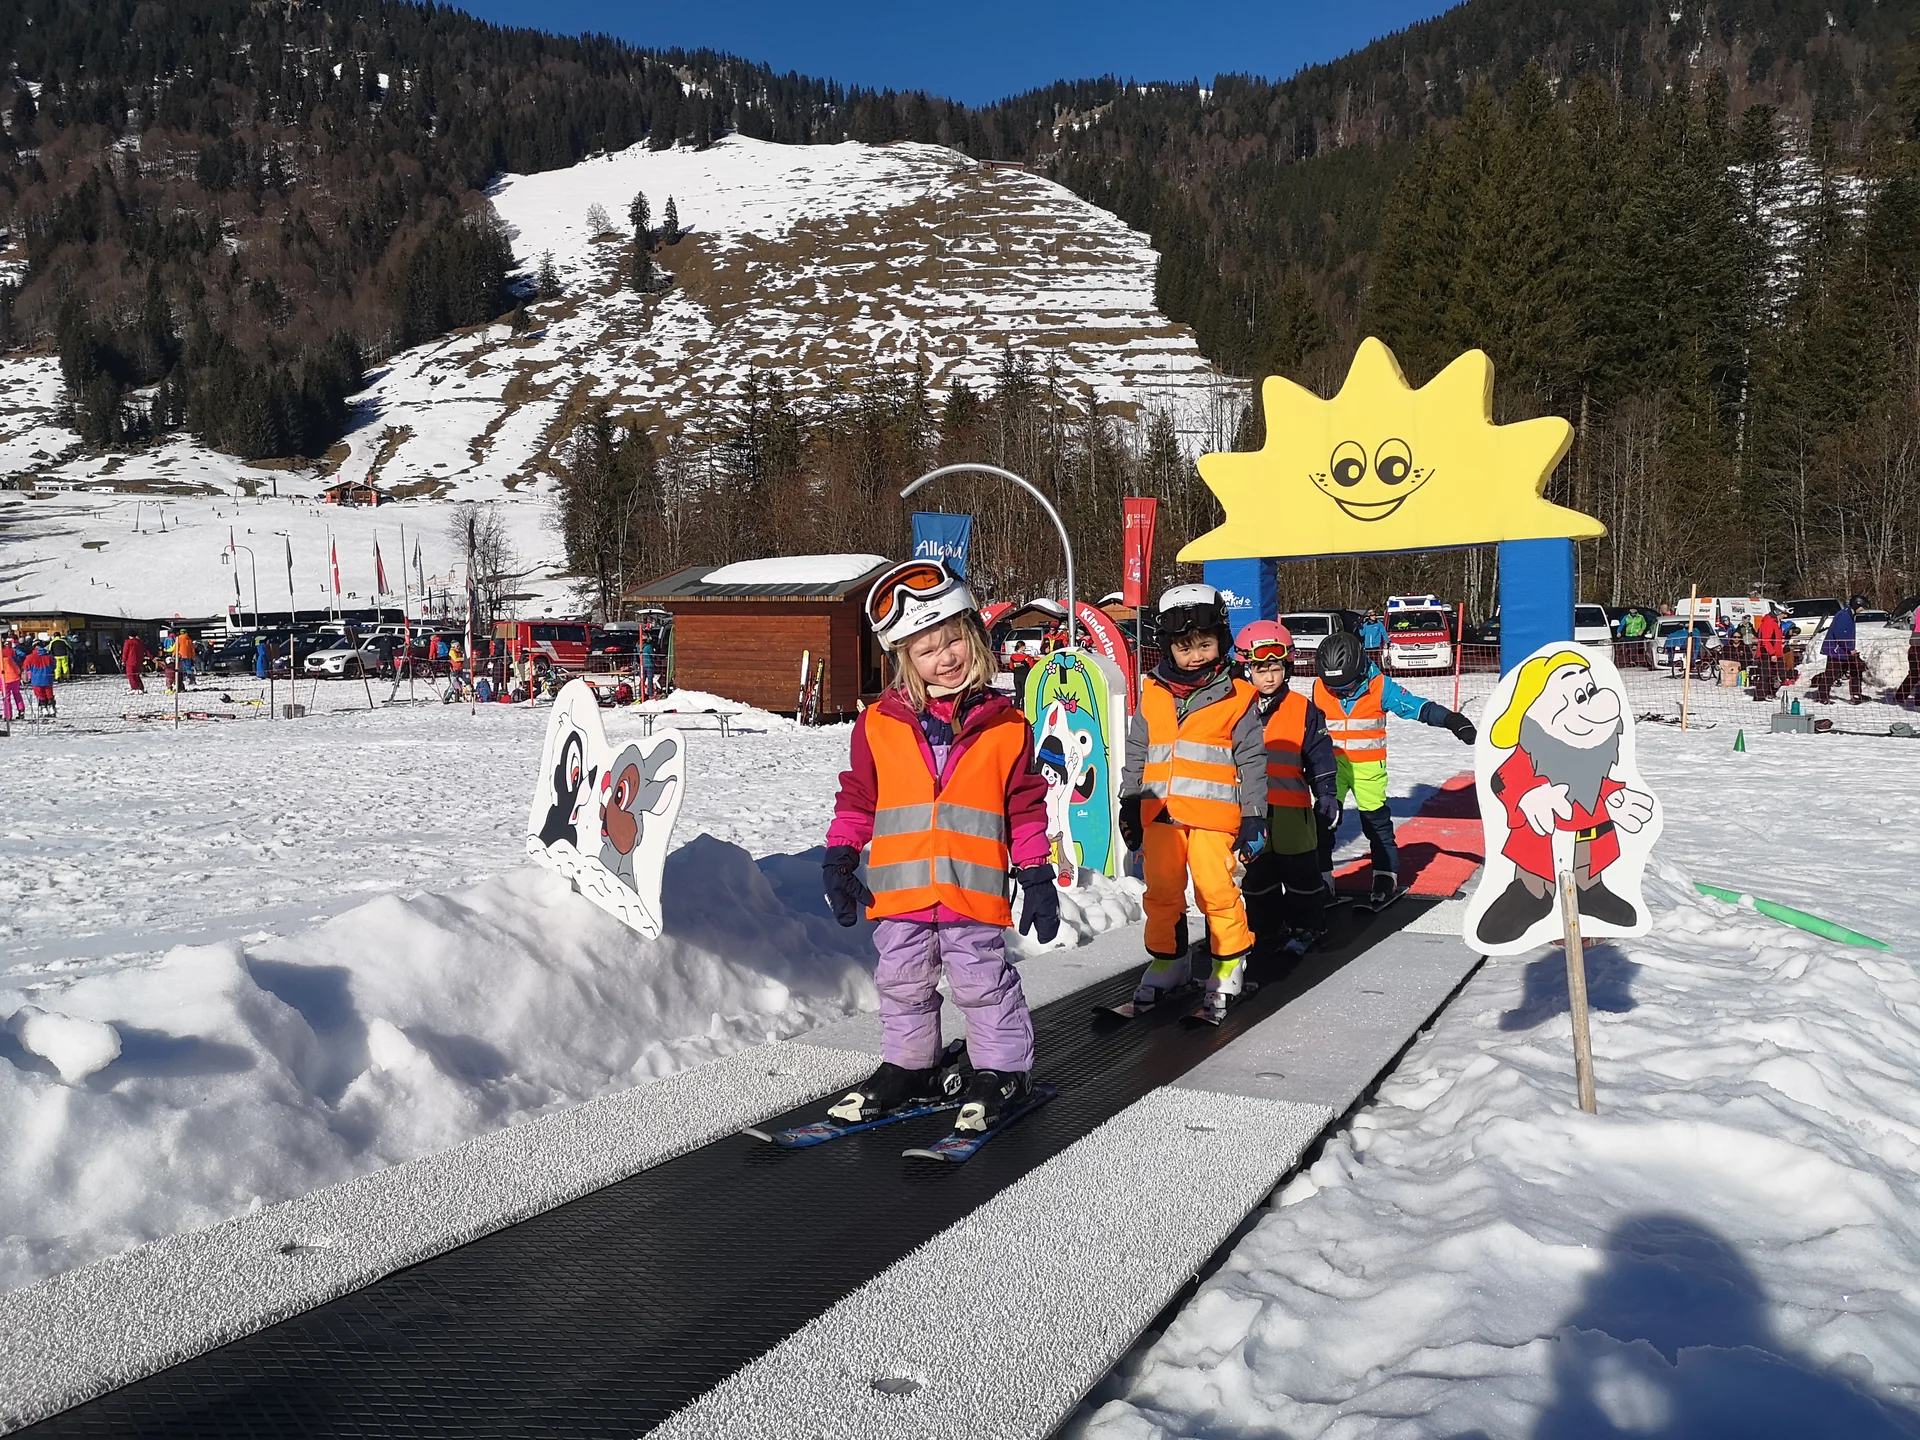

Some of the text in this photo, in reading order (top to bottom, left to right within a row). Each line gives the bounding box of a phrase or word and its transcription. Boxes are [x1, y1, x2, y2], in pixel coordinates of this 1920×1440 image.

[915, 540, 965, 562] Allgäu
[979, 610, 992, 622] is
[1080, 608, 1120, 669] Kinderlan
